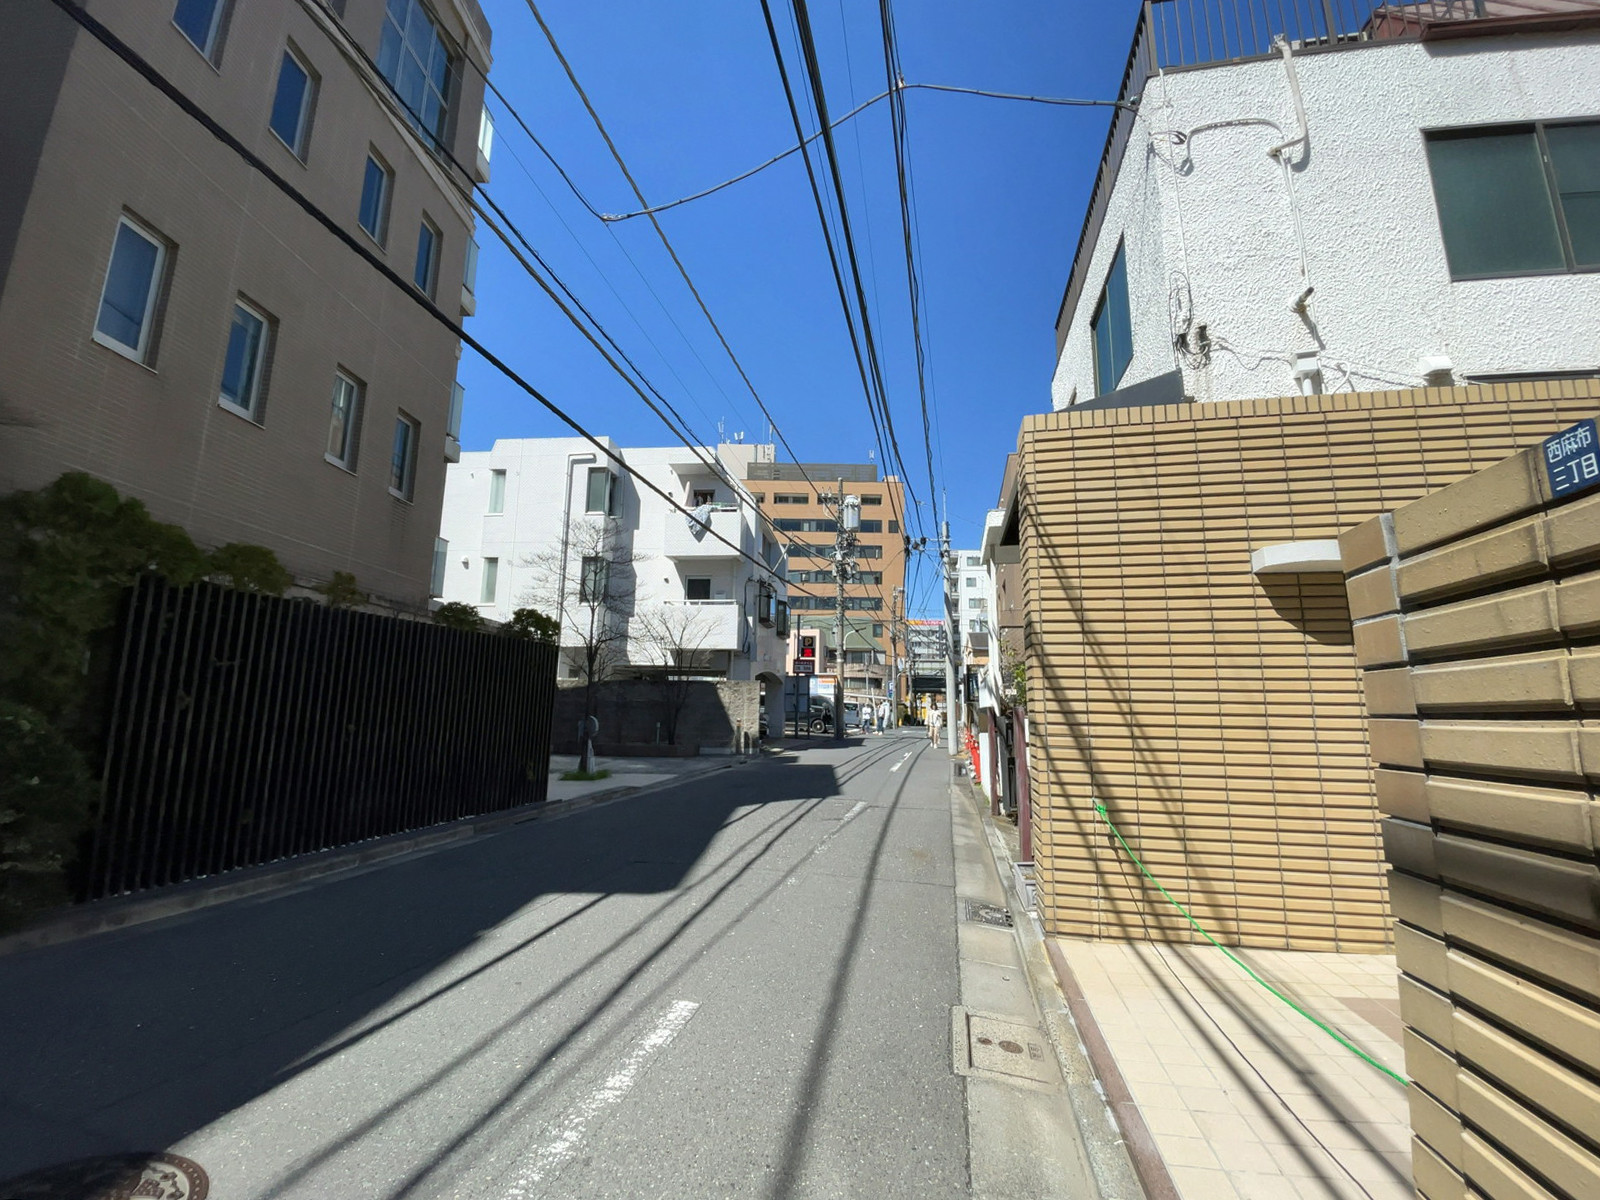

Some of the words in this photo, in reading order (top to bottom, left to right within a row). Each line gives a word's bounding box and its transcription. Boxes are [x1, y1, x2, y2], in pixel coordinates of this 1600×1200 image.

[1546, 426, 1591, 463] 西麻布
[1553, 452, 1599, 490] 三丁目
